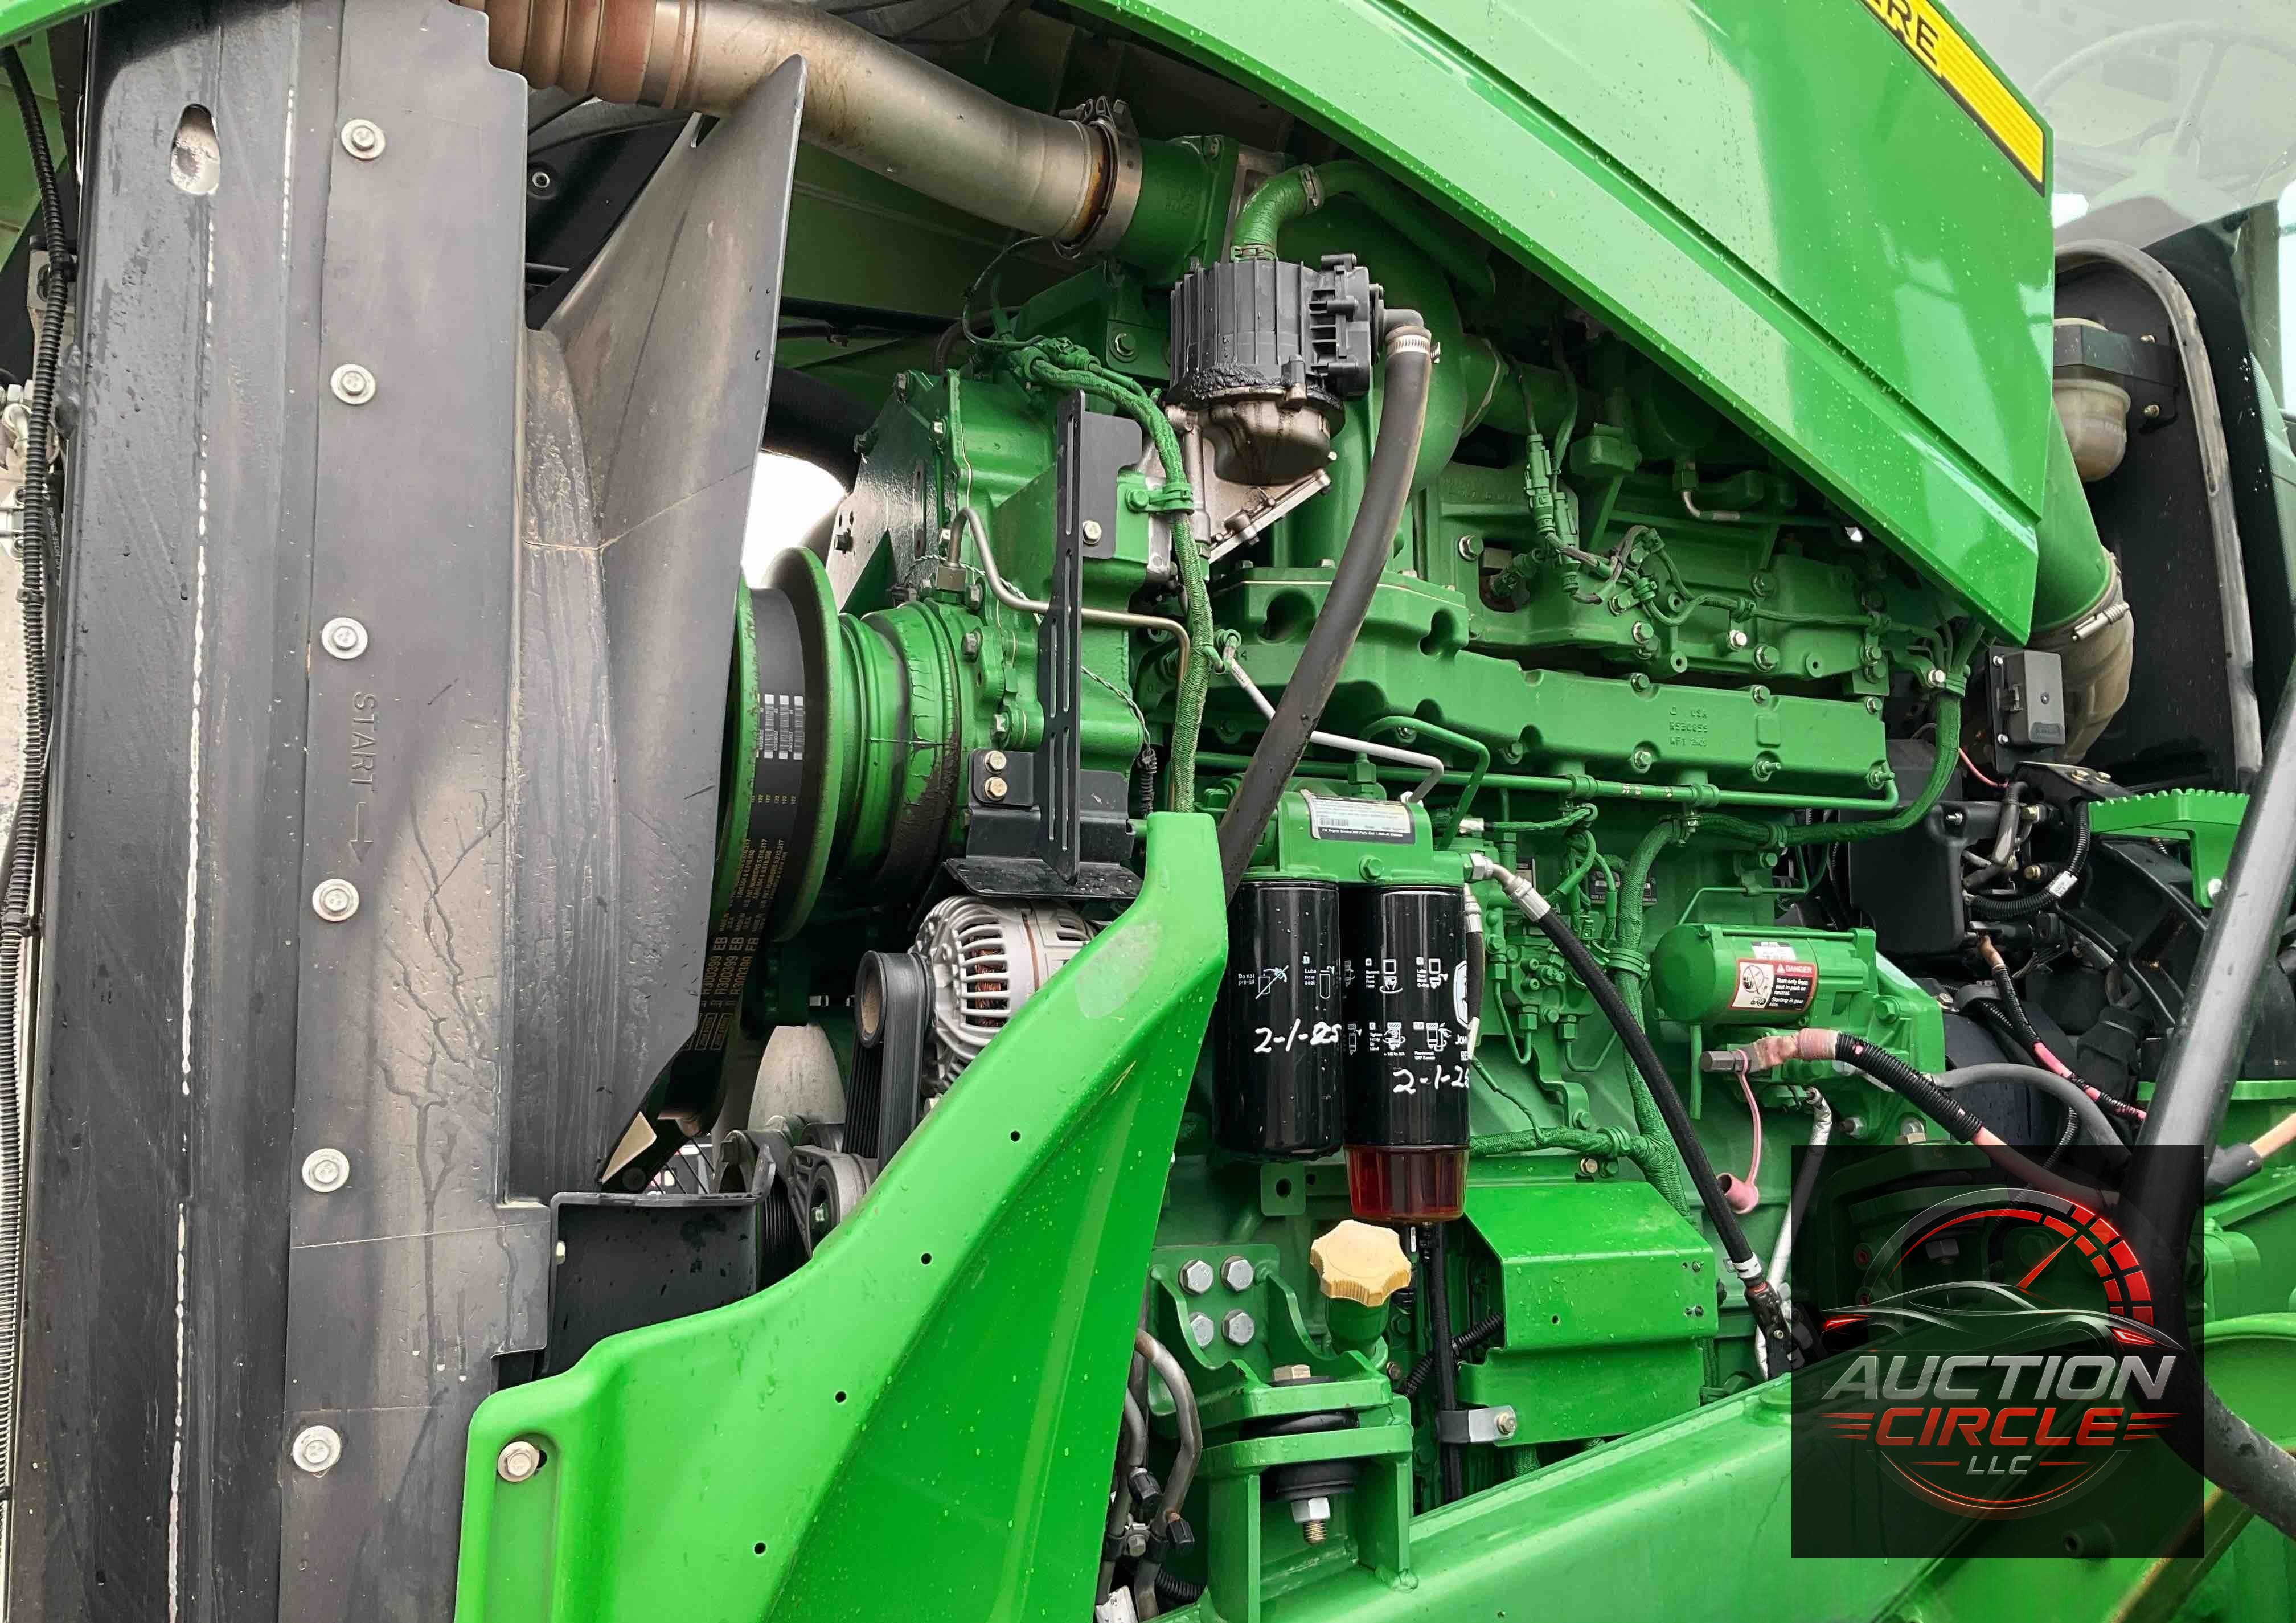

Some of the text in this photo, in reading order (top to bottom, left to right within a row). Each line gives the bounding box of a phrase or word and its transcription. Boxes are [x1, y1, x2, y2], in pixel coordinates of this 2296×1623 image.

[1872, 0, 1938, 66] RE
[52, 536, 61, 556] HOSE
[350, 692, 378, 793] START
[728, 936, 744, 951] EB
[1785, 964, 1813, 974] DANGER
[1455, 1034, 1468, 1044] JOH
